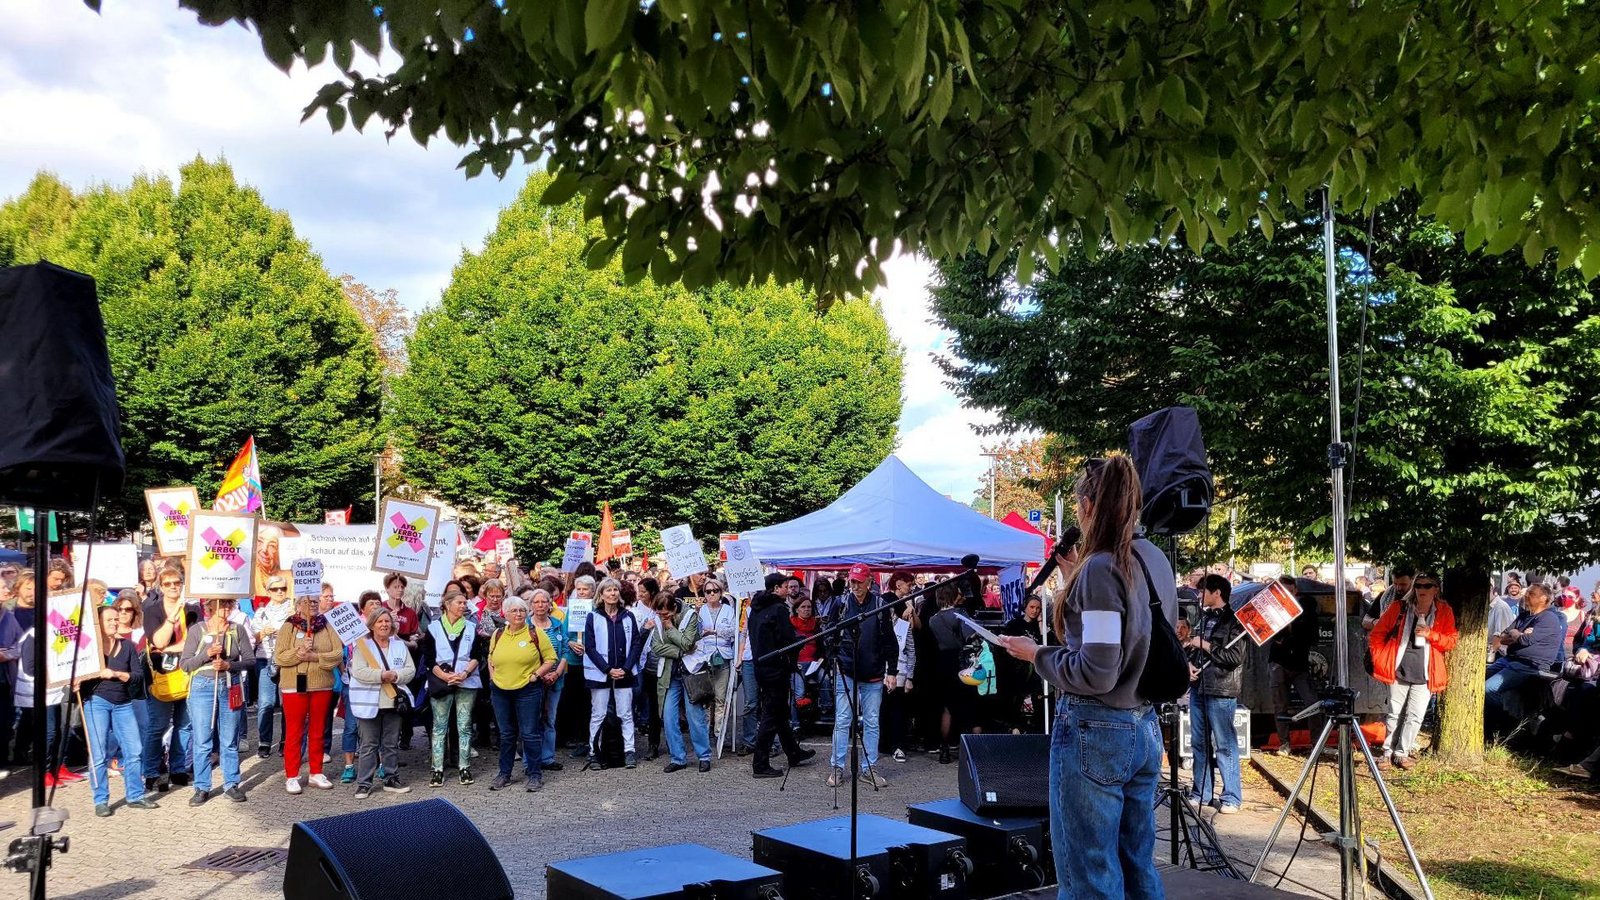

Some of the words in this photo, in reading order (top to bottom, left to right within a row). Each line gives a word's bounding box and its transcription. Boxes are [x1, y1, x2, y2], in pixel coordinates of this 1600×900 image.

[1031, 511, 1039, 521] P
[392, 528, 422, 538] VERBOT
[396, 535, 418, 544] JETZT
[204, 546, 241, 554] VERBOT
[338, 548, 349, 556] auf
[330, 606, 348, 618] OMAS
[60, 619, 76, 628] AFD
[334, 612, 356, 627] GEGEN
[53, 626, 82, 636] VERBO
[338, 618, 362, 635] RECHTS
[60, 634, 80, 643] JETZ
